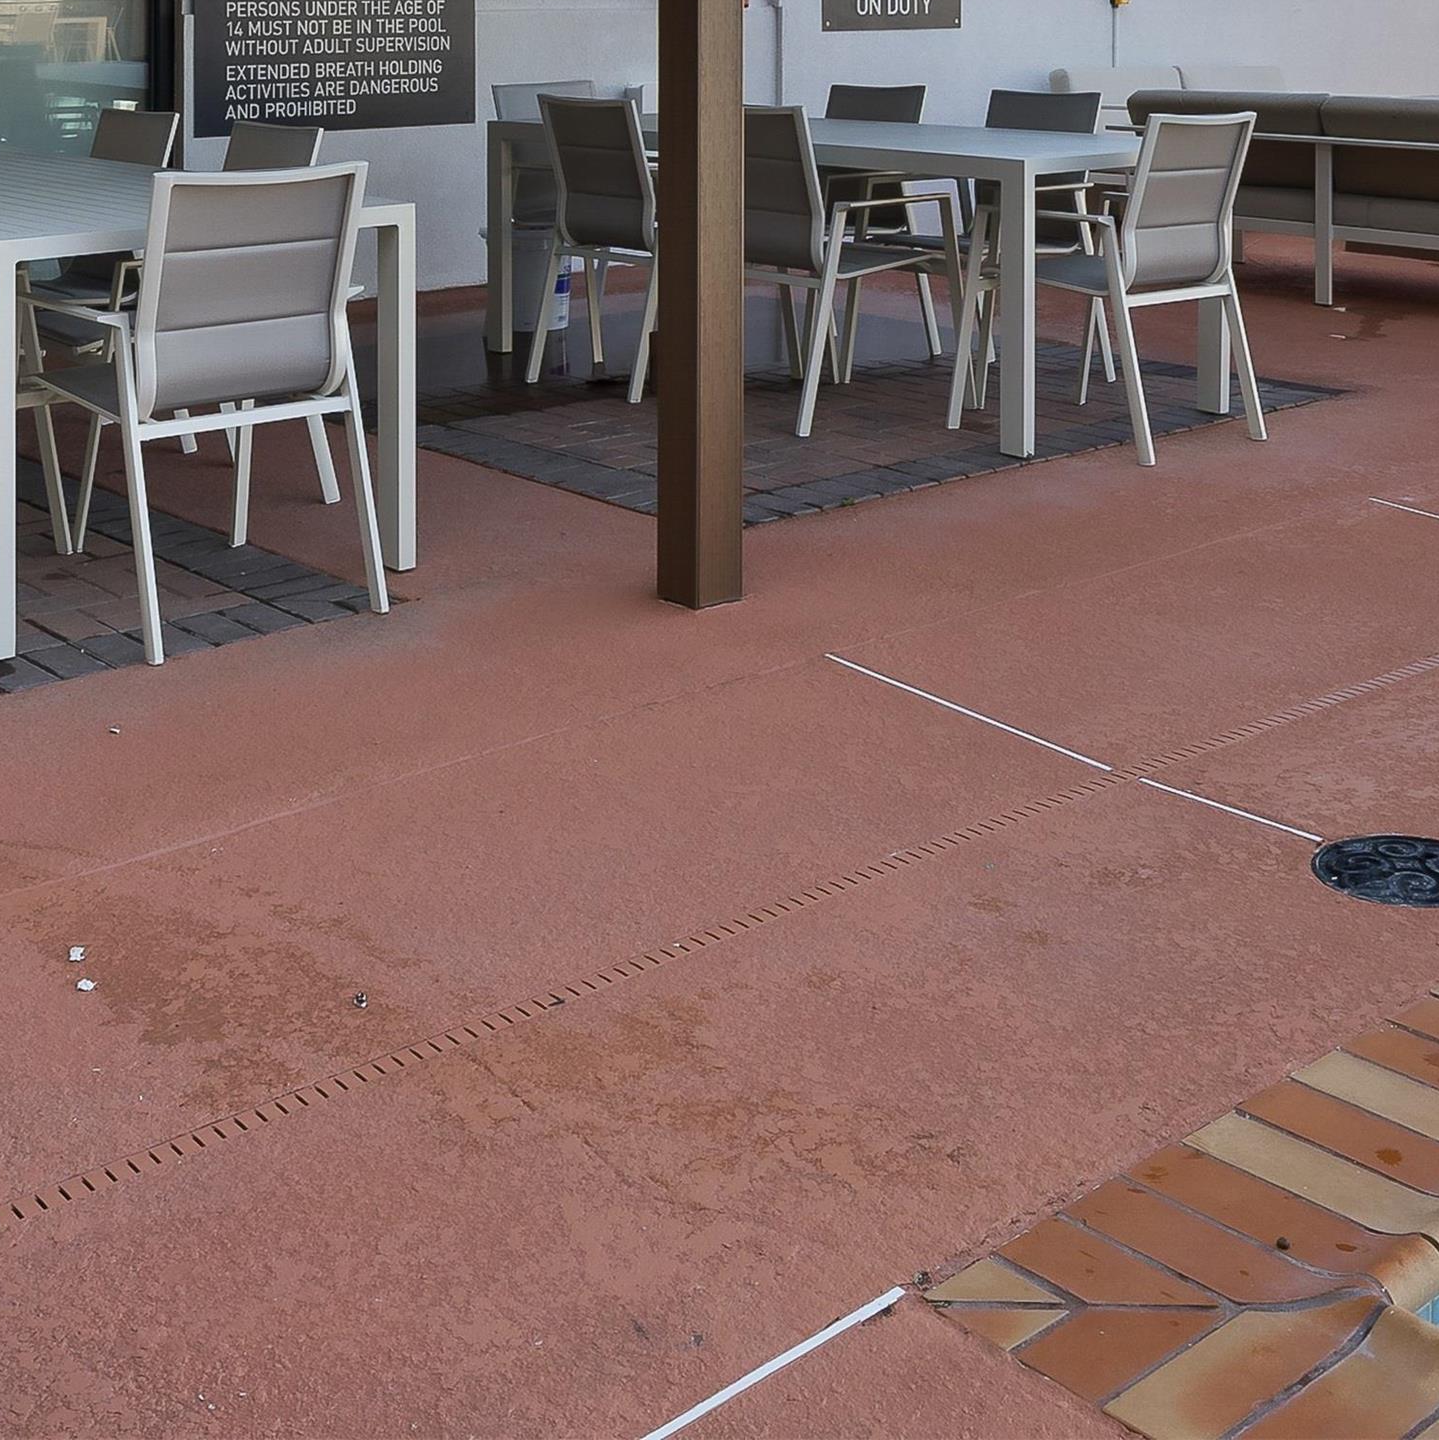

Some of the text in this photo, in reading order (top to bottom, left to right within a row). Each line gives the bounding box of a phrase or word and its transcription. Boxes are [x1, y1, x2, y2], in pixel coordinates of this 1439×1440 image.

[227, 0, 445, 17] PERSONS UNDER THE AGE OF
[227, 18, 446, 36] 14 MUST NOT BE IN THE POOL
[226, 36, 449, 56] WITHOUT ADULT SUPERVISION
[227, 59, 442, 81] EXTENDED BREATH HOLDING
[226, 78, 438, 100] ACTIVITIES ARE DANGEROUS
[225, 99, 356, 119] AND PROHIBITED
